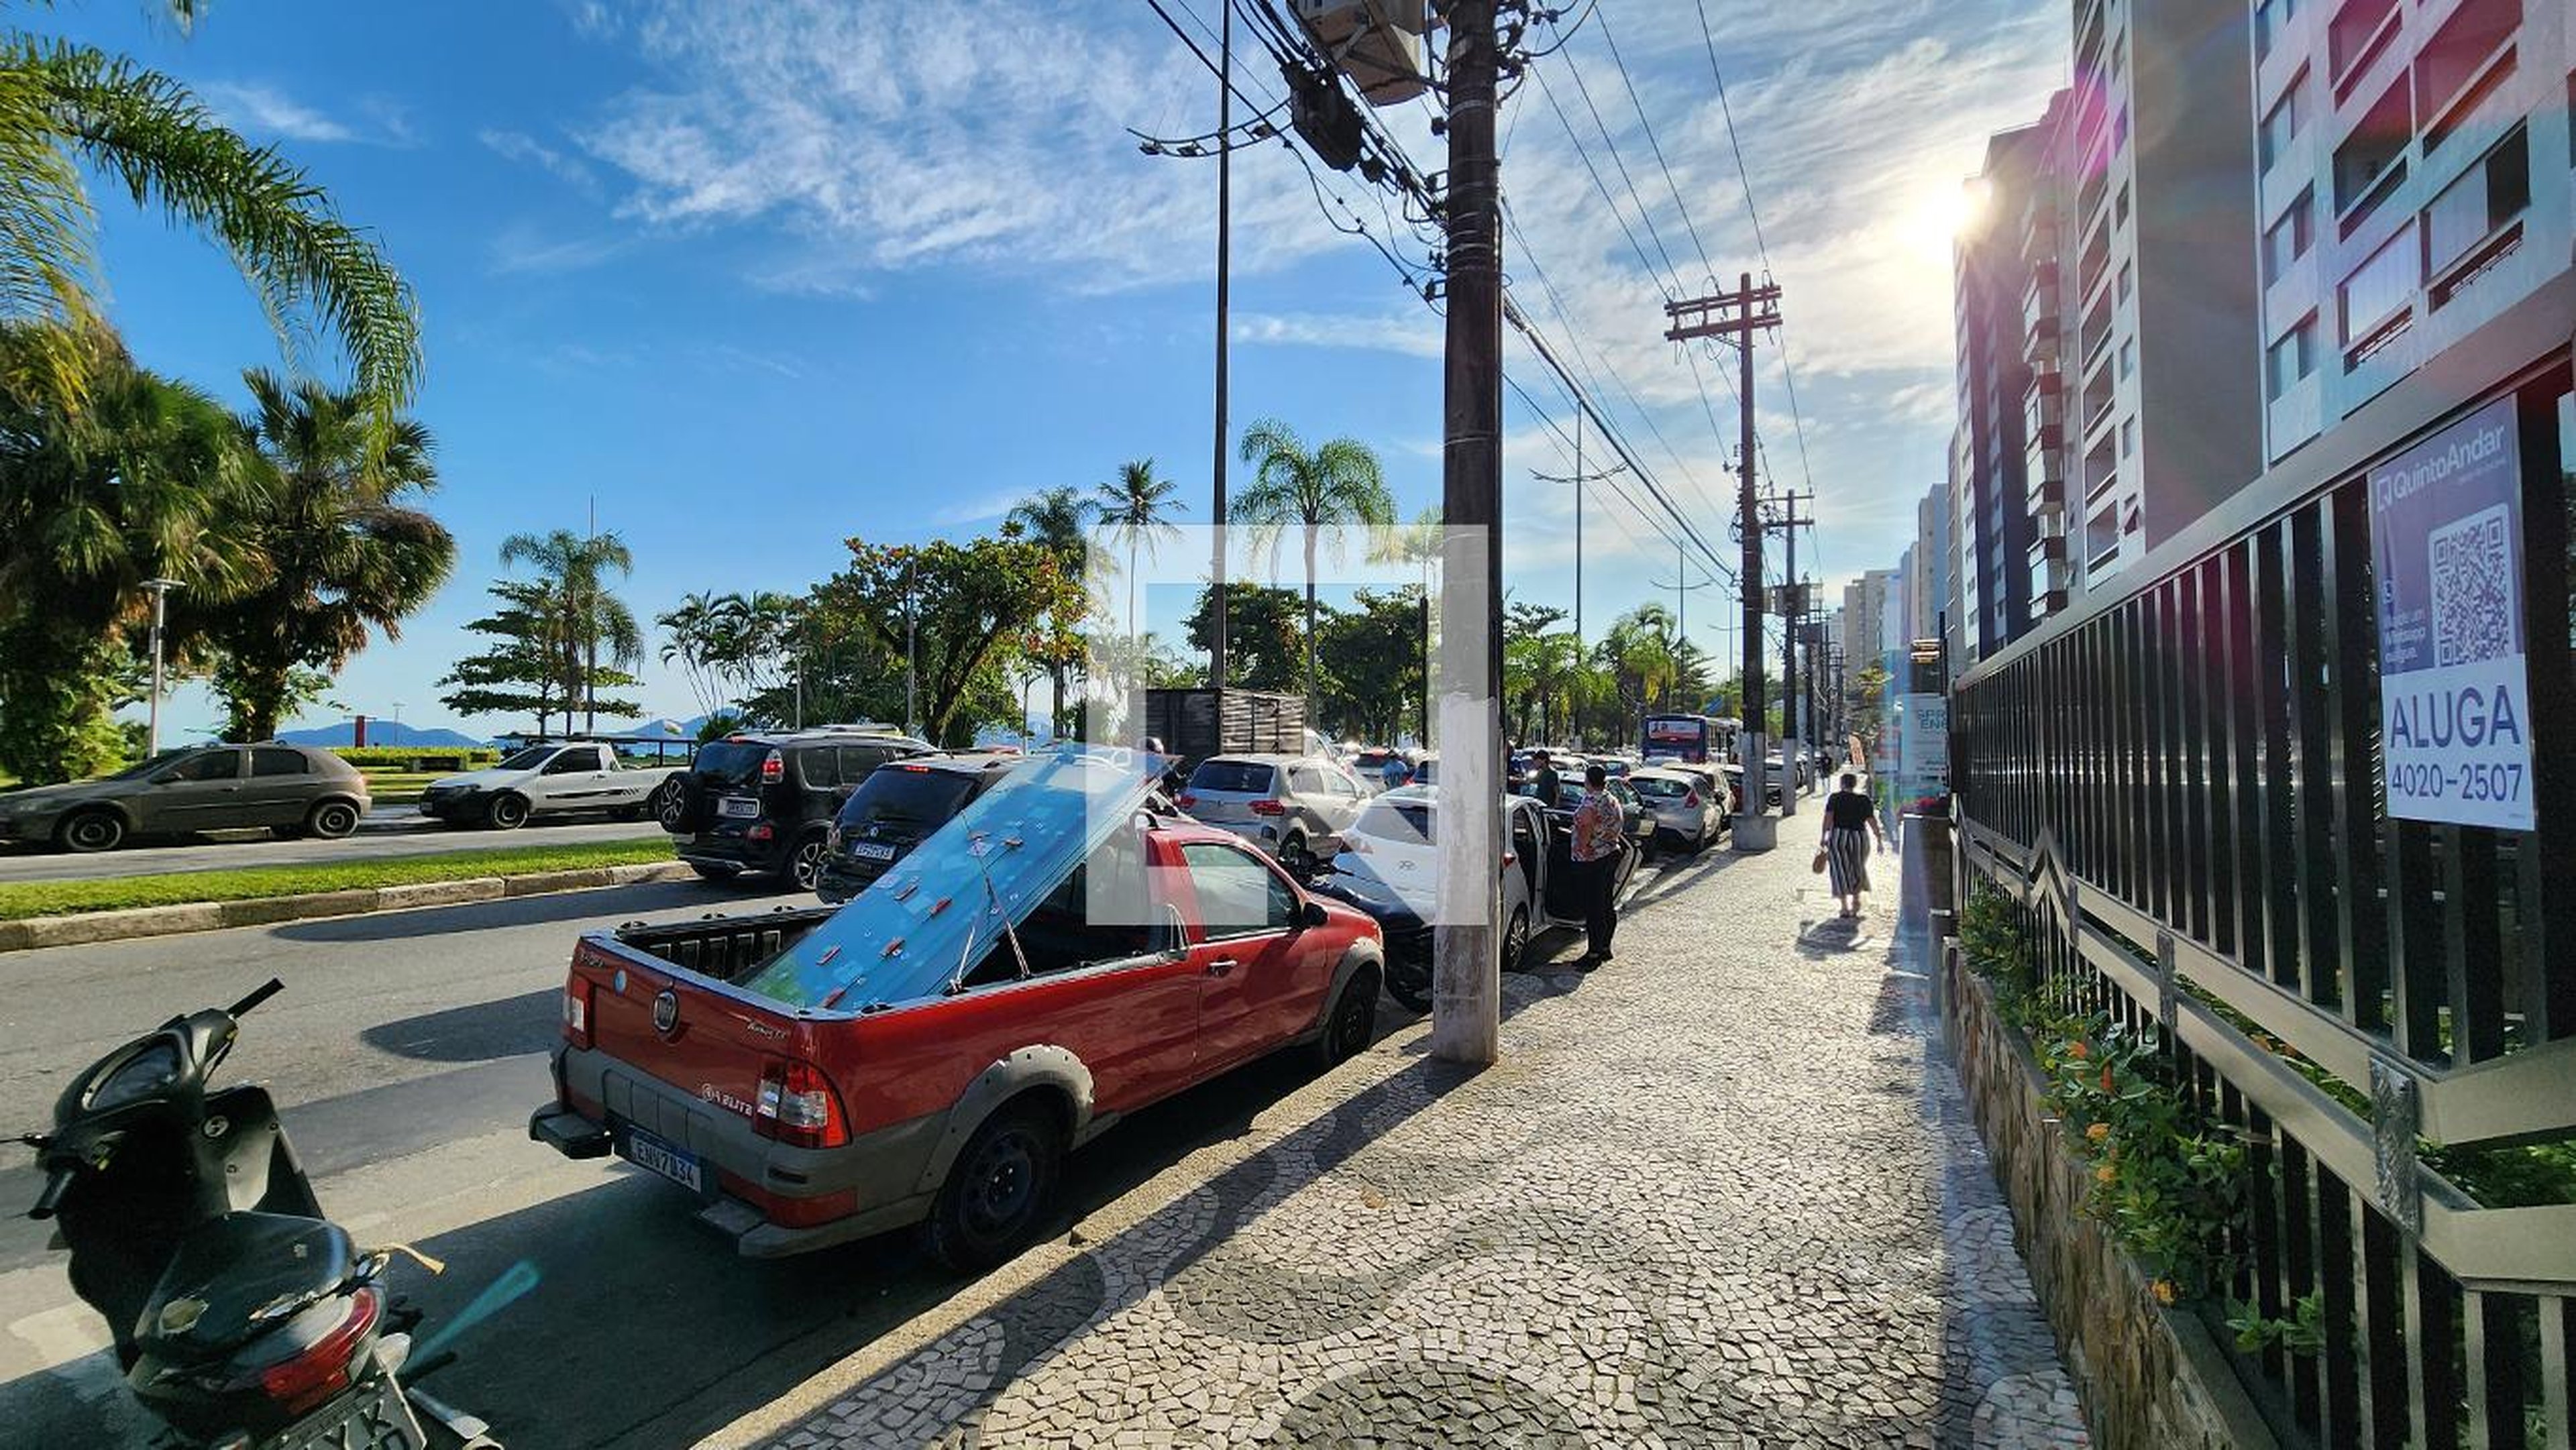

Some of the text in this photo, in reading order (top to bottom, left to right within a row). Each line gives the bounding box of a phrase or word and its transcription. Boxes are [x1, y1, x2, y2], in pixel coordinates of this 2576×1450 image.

[2394, 425, 2505, 500] QuintoAndar
[2390, 685, 2520, 748] ALUGA
[2392, 763, 2522, 802] 4020-2507
